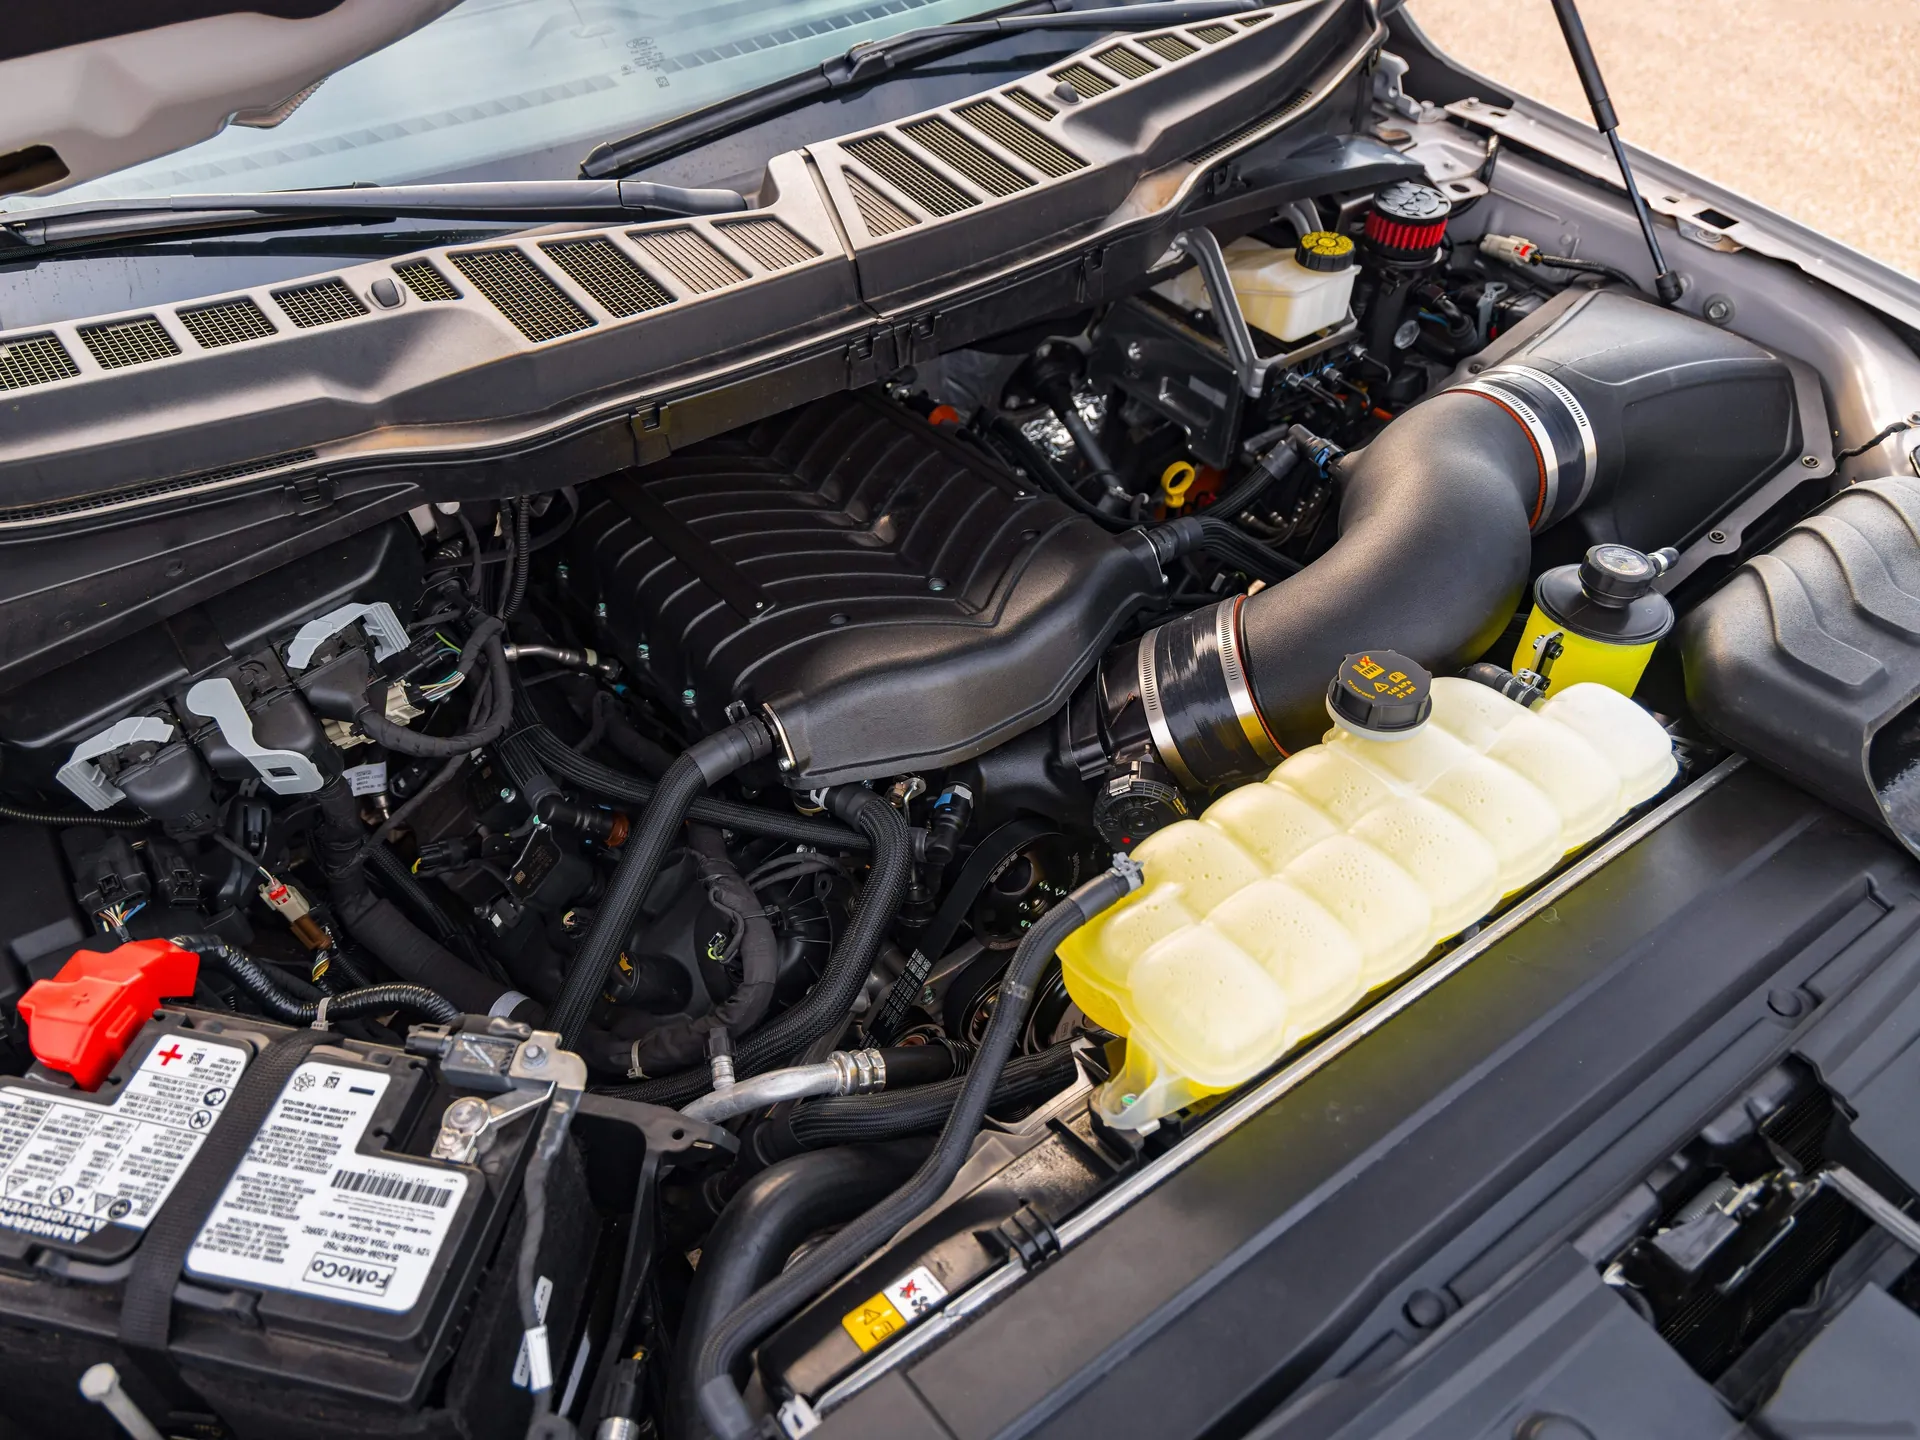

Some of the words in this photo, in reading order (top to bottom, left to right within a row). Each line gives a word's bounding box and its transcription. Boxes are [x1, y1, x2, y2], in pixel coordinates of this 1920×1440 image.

[1387, 686, 1401, 695] 145
[1398, 680, 1412, 689] kPa
[1406, 685, 1416, 695] psi
[311, 1259, 393, 1289] FoMoCo
